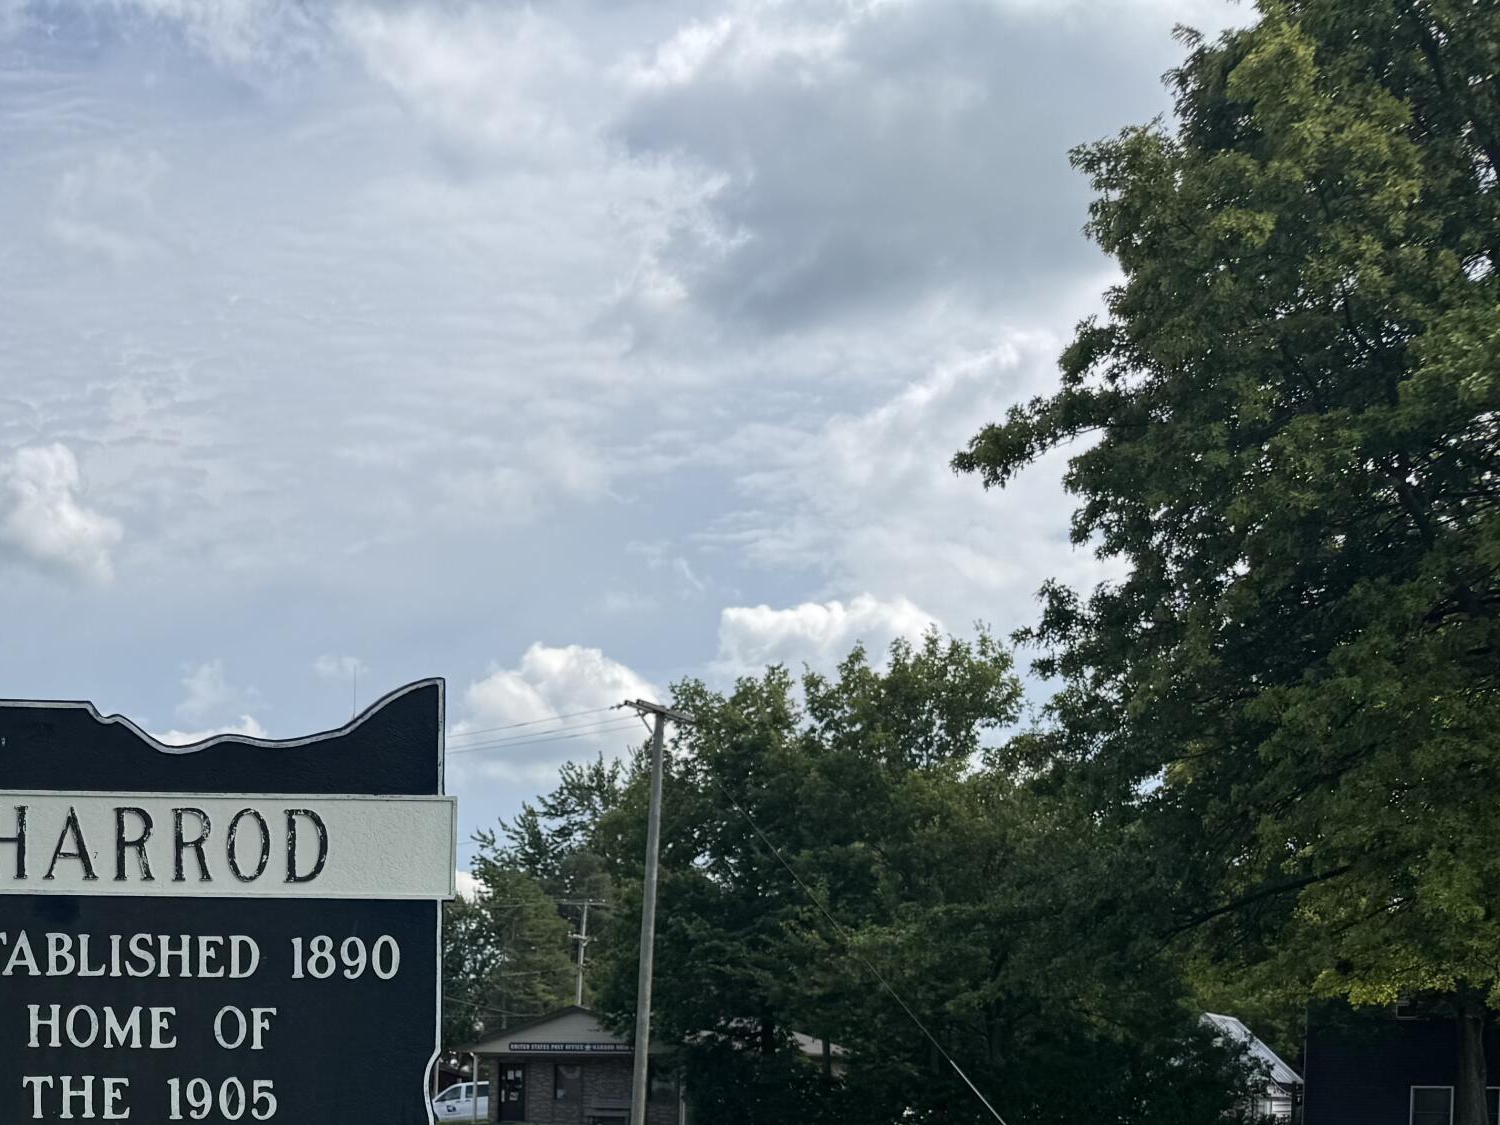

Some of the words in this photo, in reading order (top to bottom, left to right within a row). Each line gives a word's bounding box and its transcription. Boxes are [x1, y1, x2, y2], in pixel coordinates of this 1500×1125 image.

[291, 934, 401, 981] 1890
[27, 1004, 178, 1050] HOME
[213, 1006, 278, 1050] OF
[22, 1076, 131, 1121] THE
[168, 1078, 278, 1121] 1905
